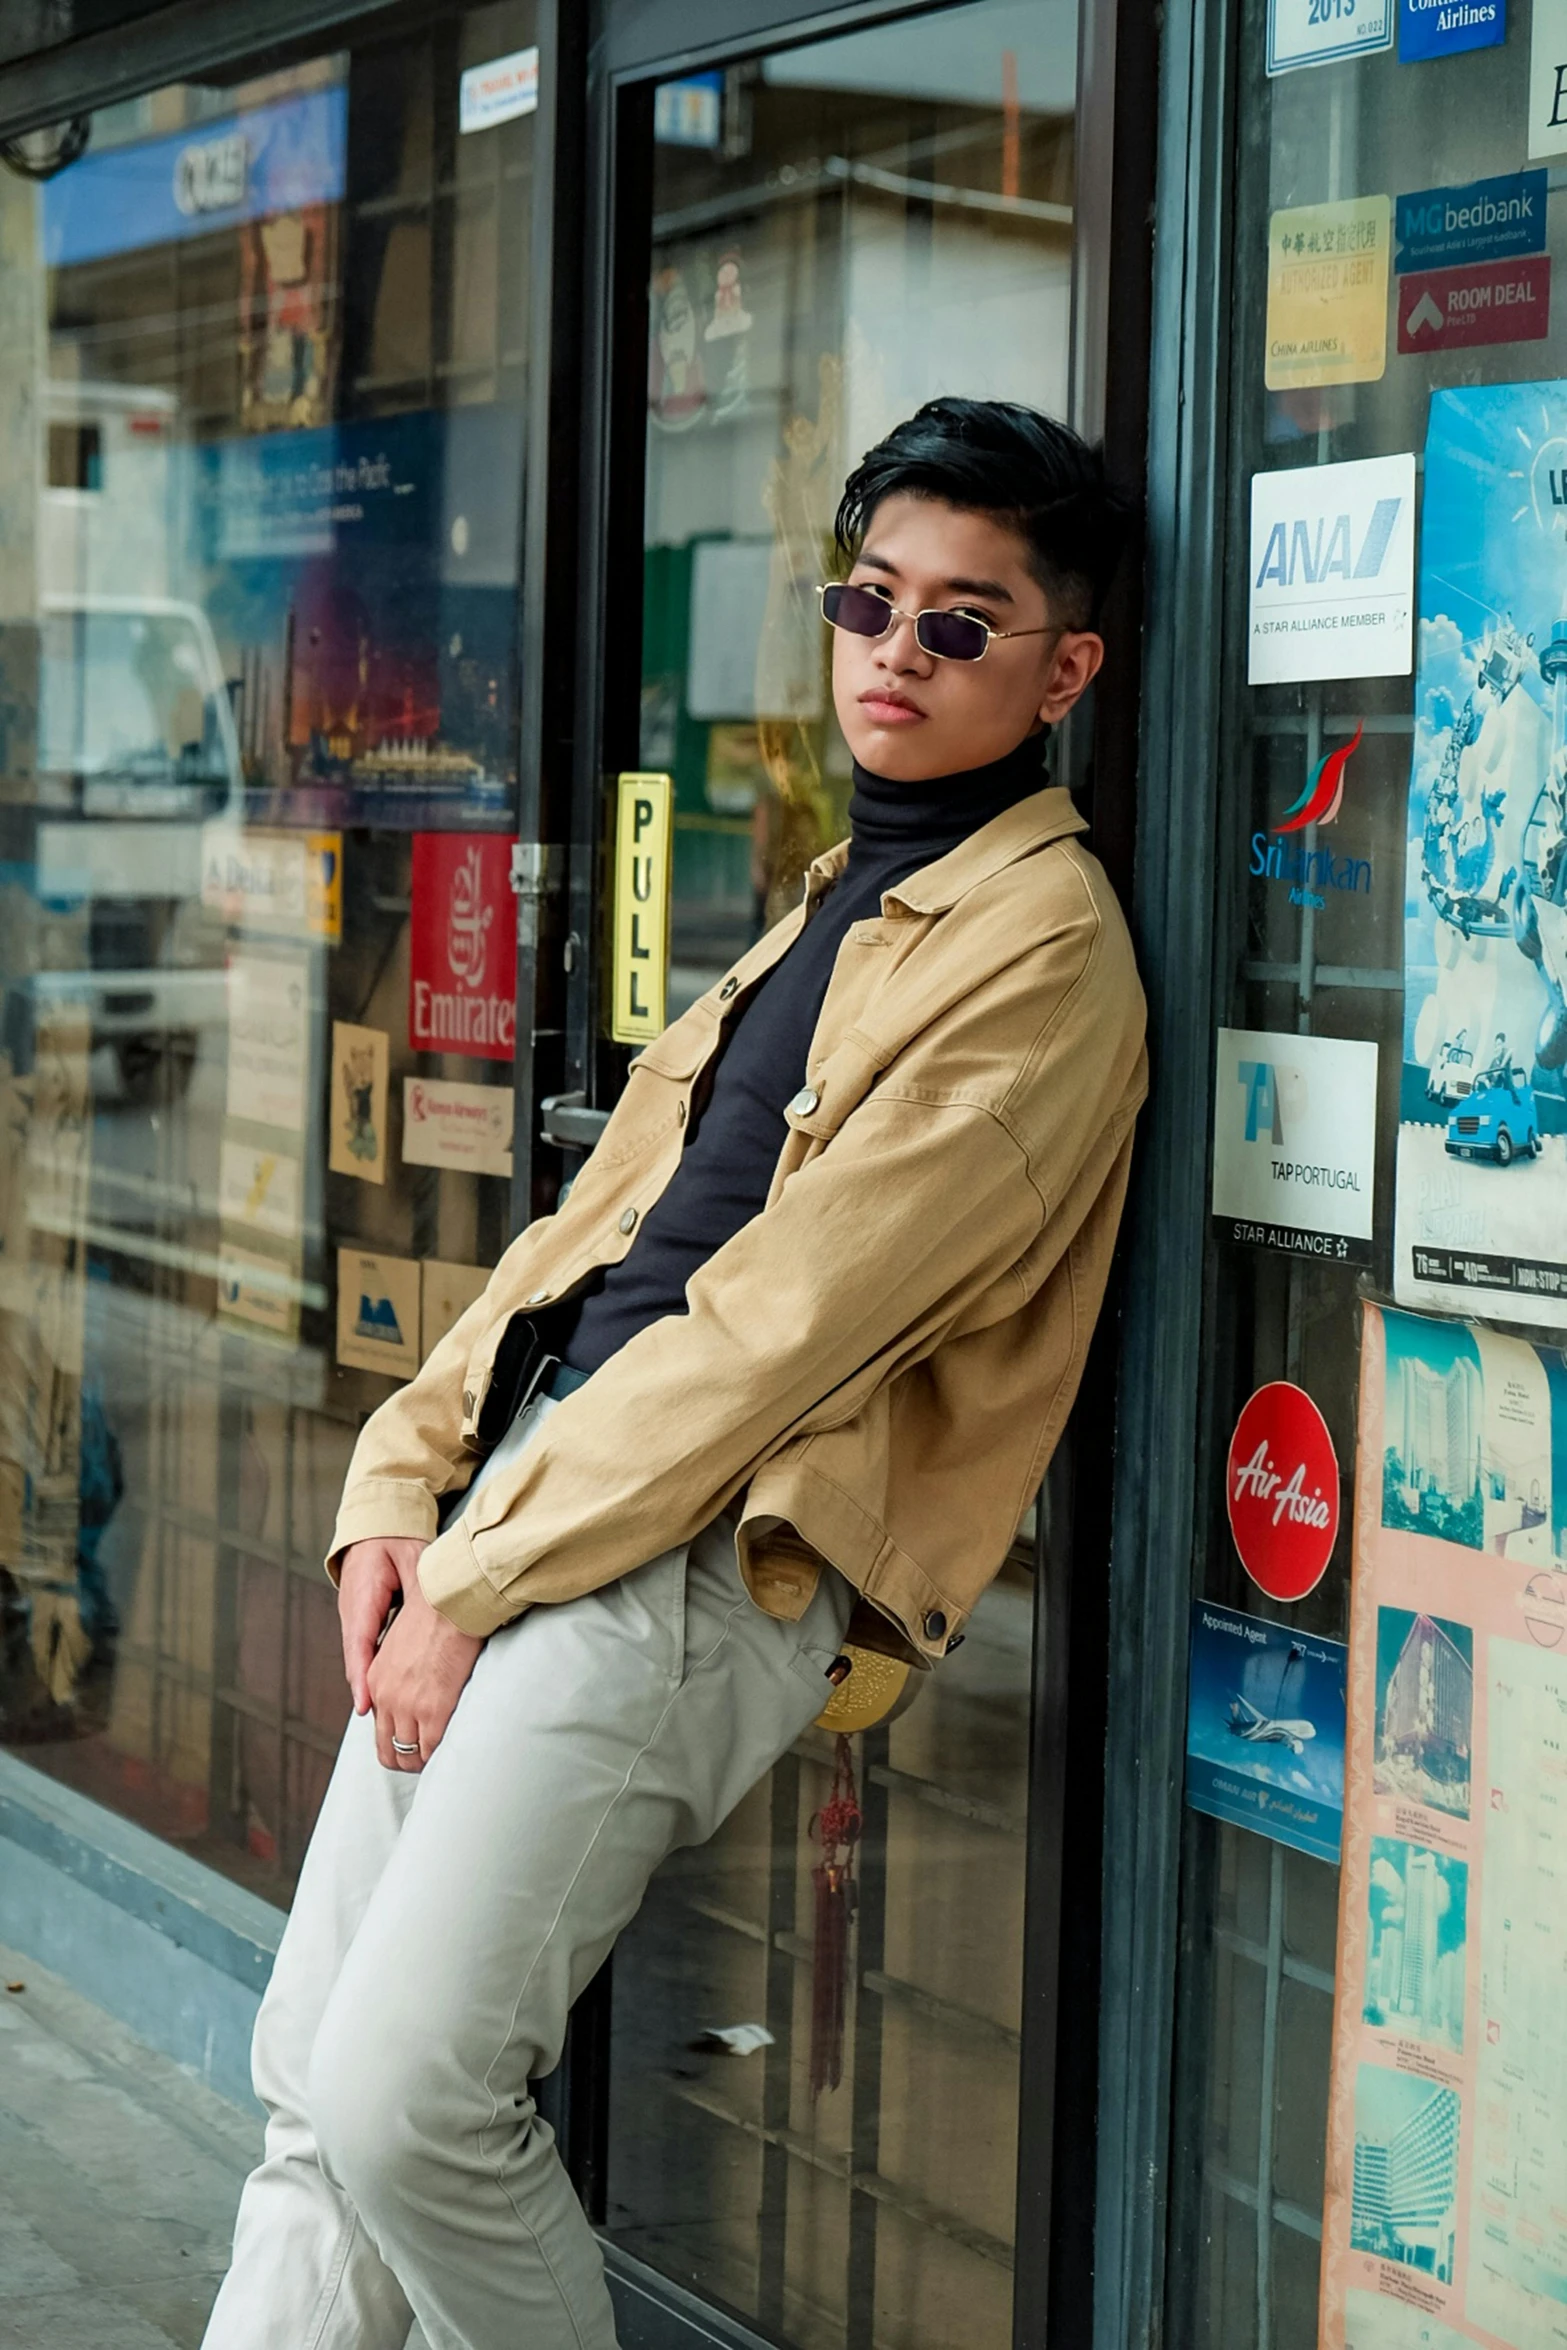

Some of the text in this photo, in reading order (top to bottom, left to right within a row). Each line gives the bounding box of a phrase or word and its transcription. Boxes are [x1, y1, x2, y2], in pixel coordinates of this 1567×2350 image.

[1436, 4, 1496, 31] Airlines
[1280, 259, 1375, 296] AUTHORIZED AGENT
[1447, 280, 1536, 312] ROOM DEAL
[1256, 514, 1351, 589] ANA
[1253, 612, 1386, 634] A STAR ALLIANCE MEMBER
[630, 799, 653, 1018] PULL
[1233, 1223, 1333, 1256] STAR ALLIANCE
[1463, 1261, 1479, 1283] 40
[1518, 1267, 1561, 1291] NON-STOP
[1202, 1612, 1268, 1645] Appointed Agent
[1211, 1778, 1240, 1796] OMAN
